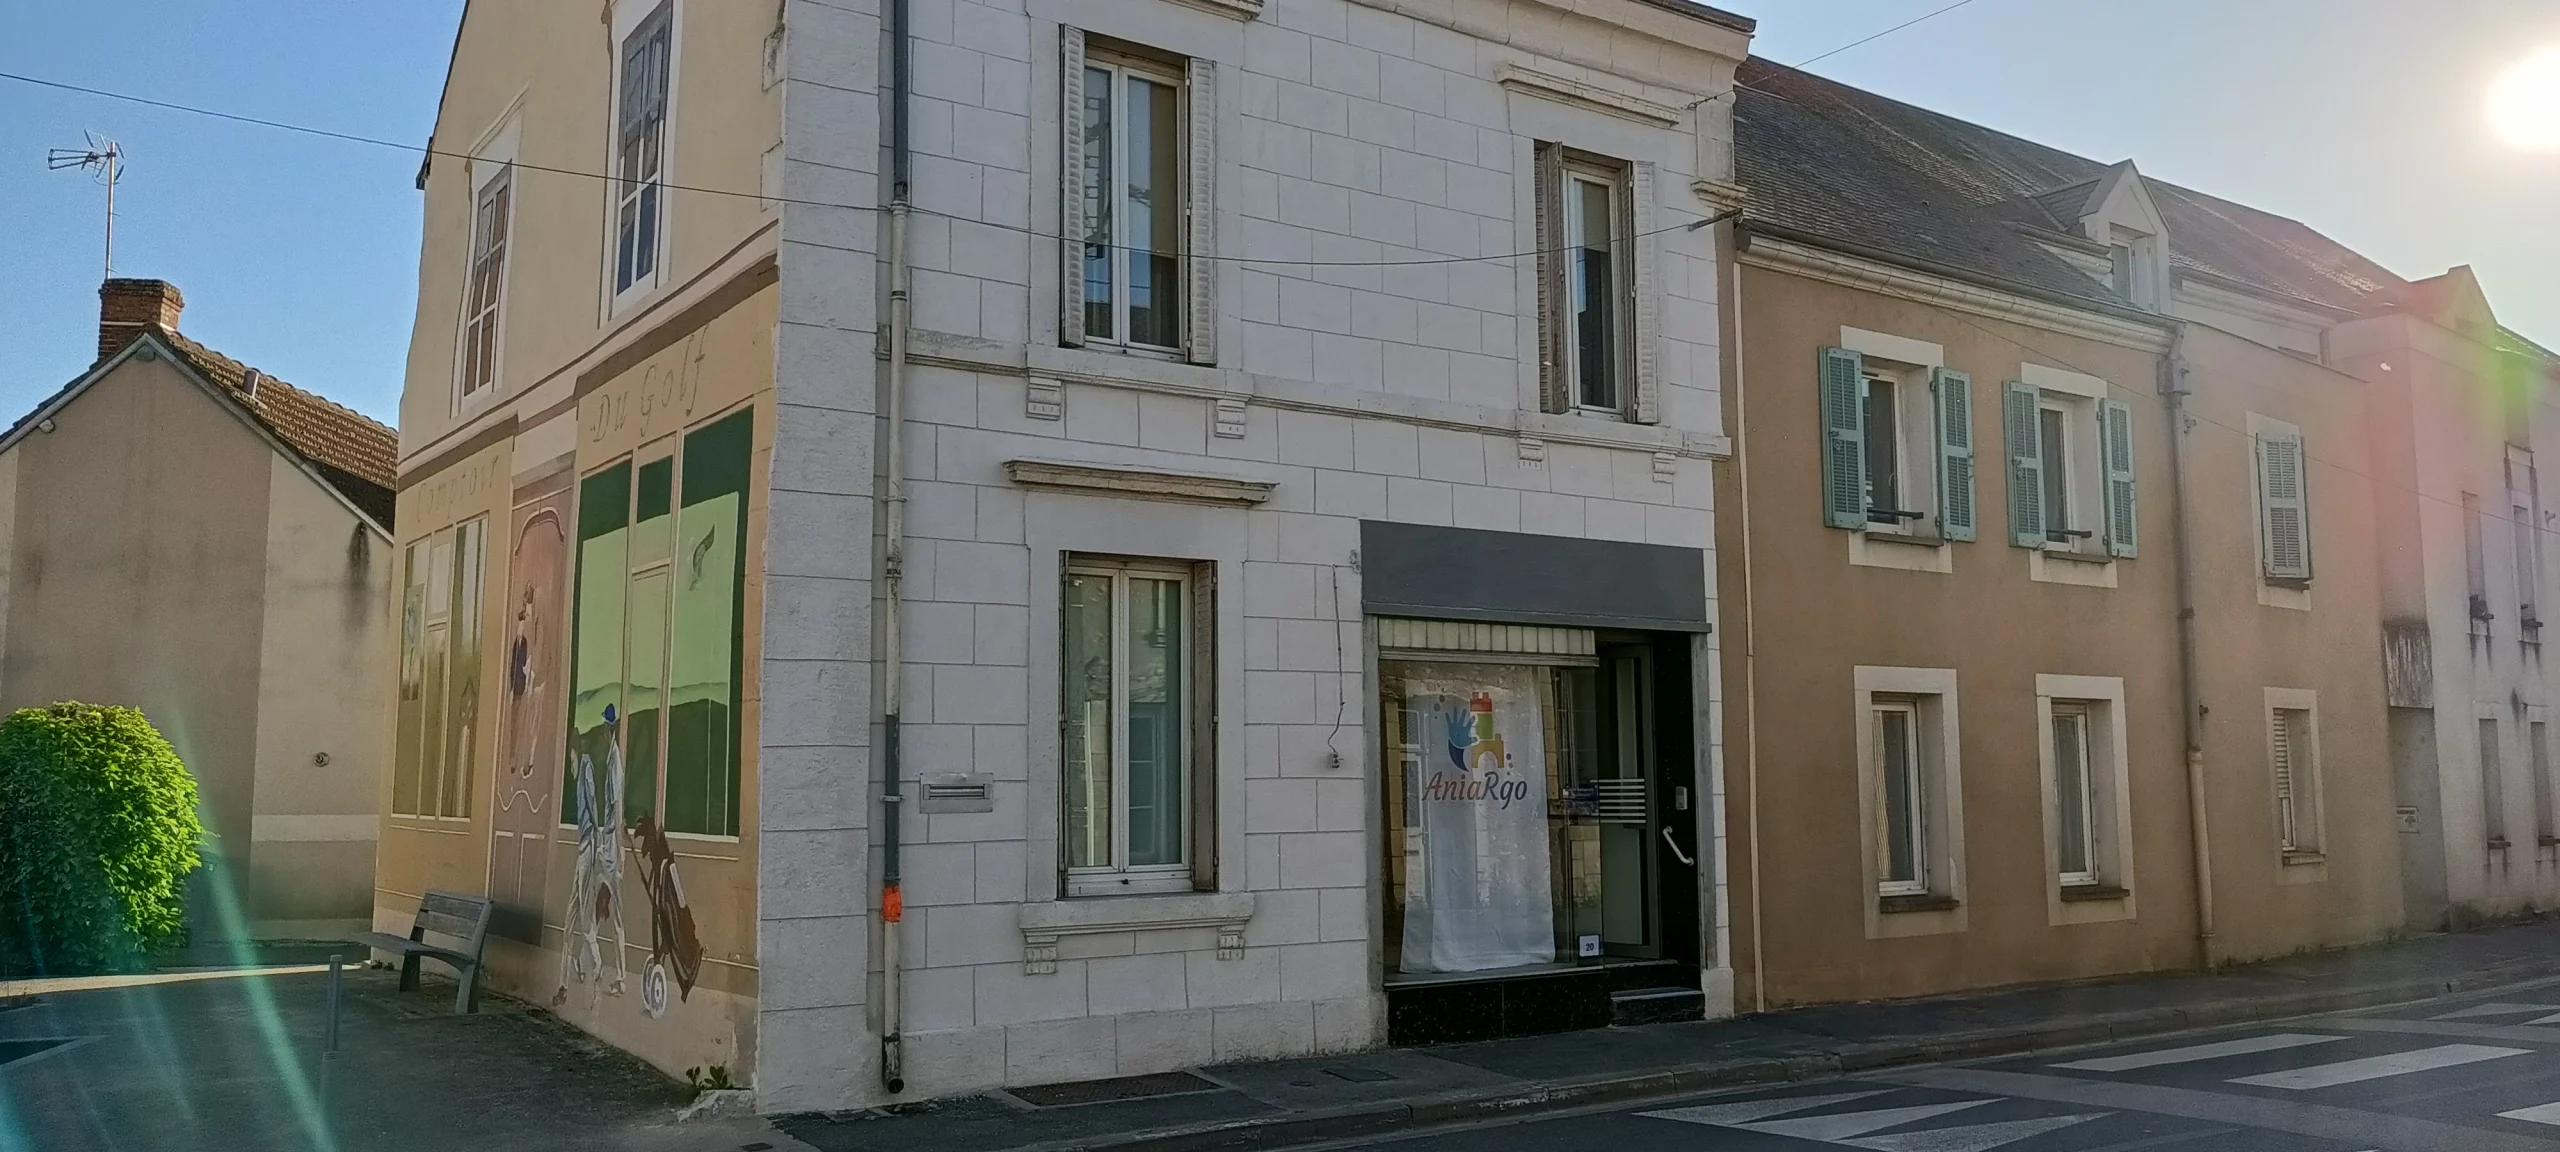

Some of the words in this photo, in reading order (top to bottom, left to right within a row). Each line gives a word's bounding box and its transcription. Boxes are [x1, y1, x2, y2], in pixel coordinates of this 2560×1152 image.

[590, 391, 628, 443] Du
[640, 323, 710, 438] Golf
[1421, 771, 1528, 810] AniaRgo
[1585, 942, 1595, 952] 20
